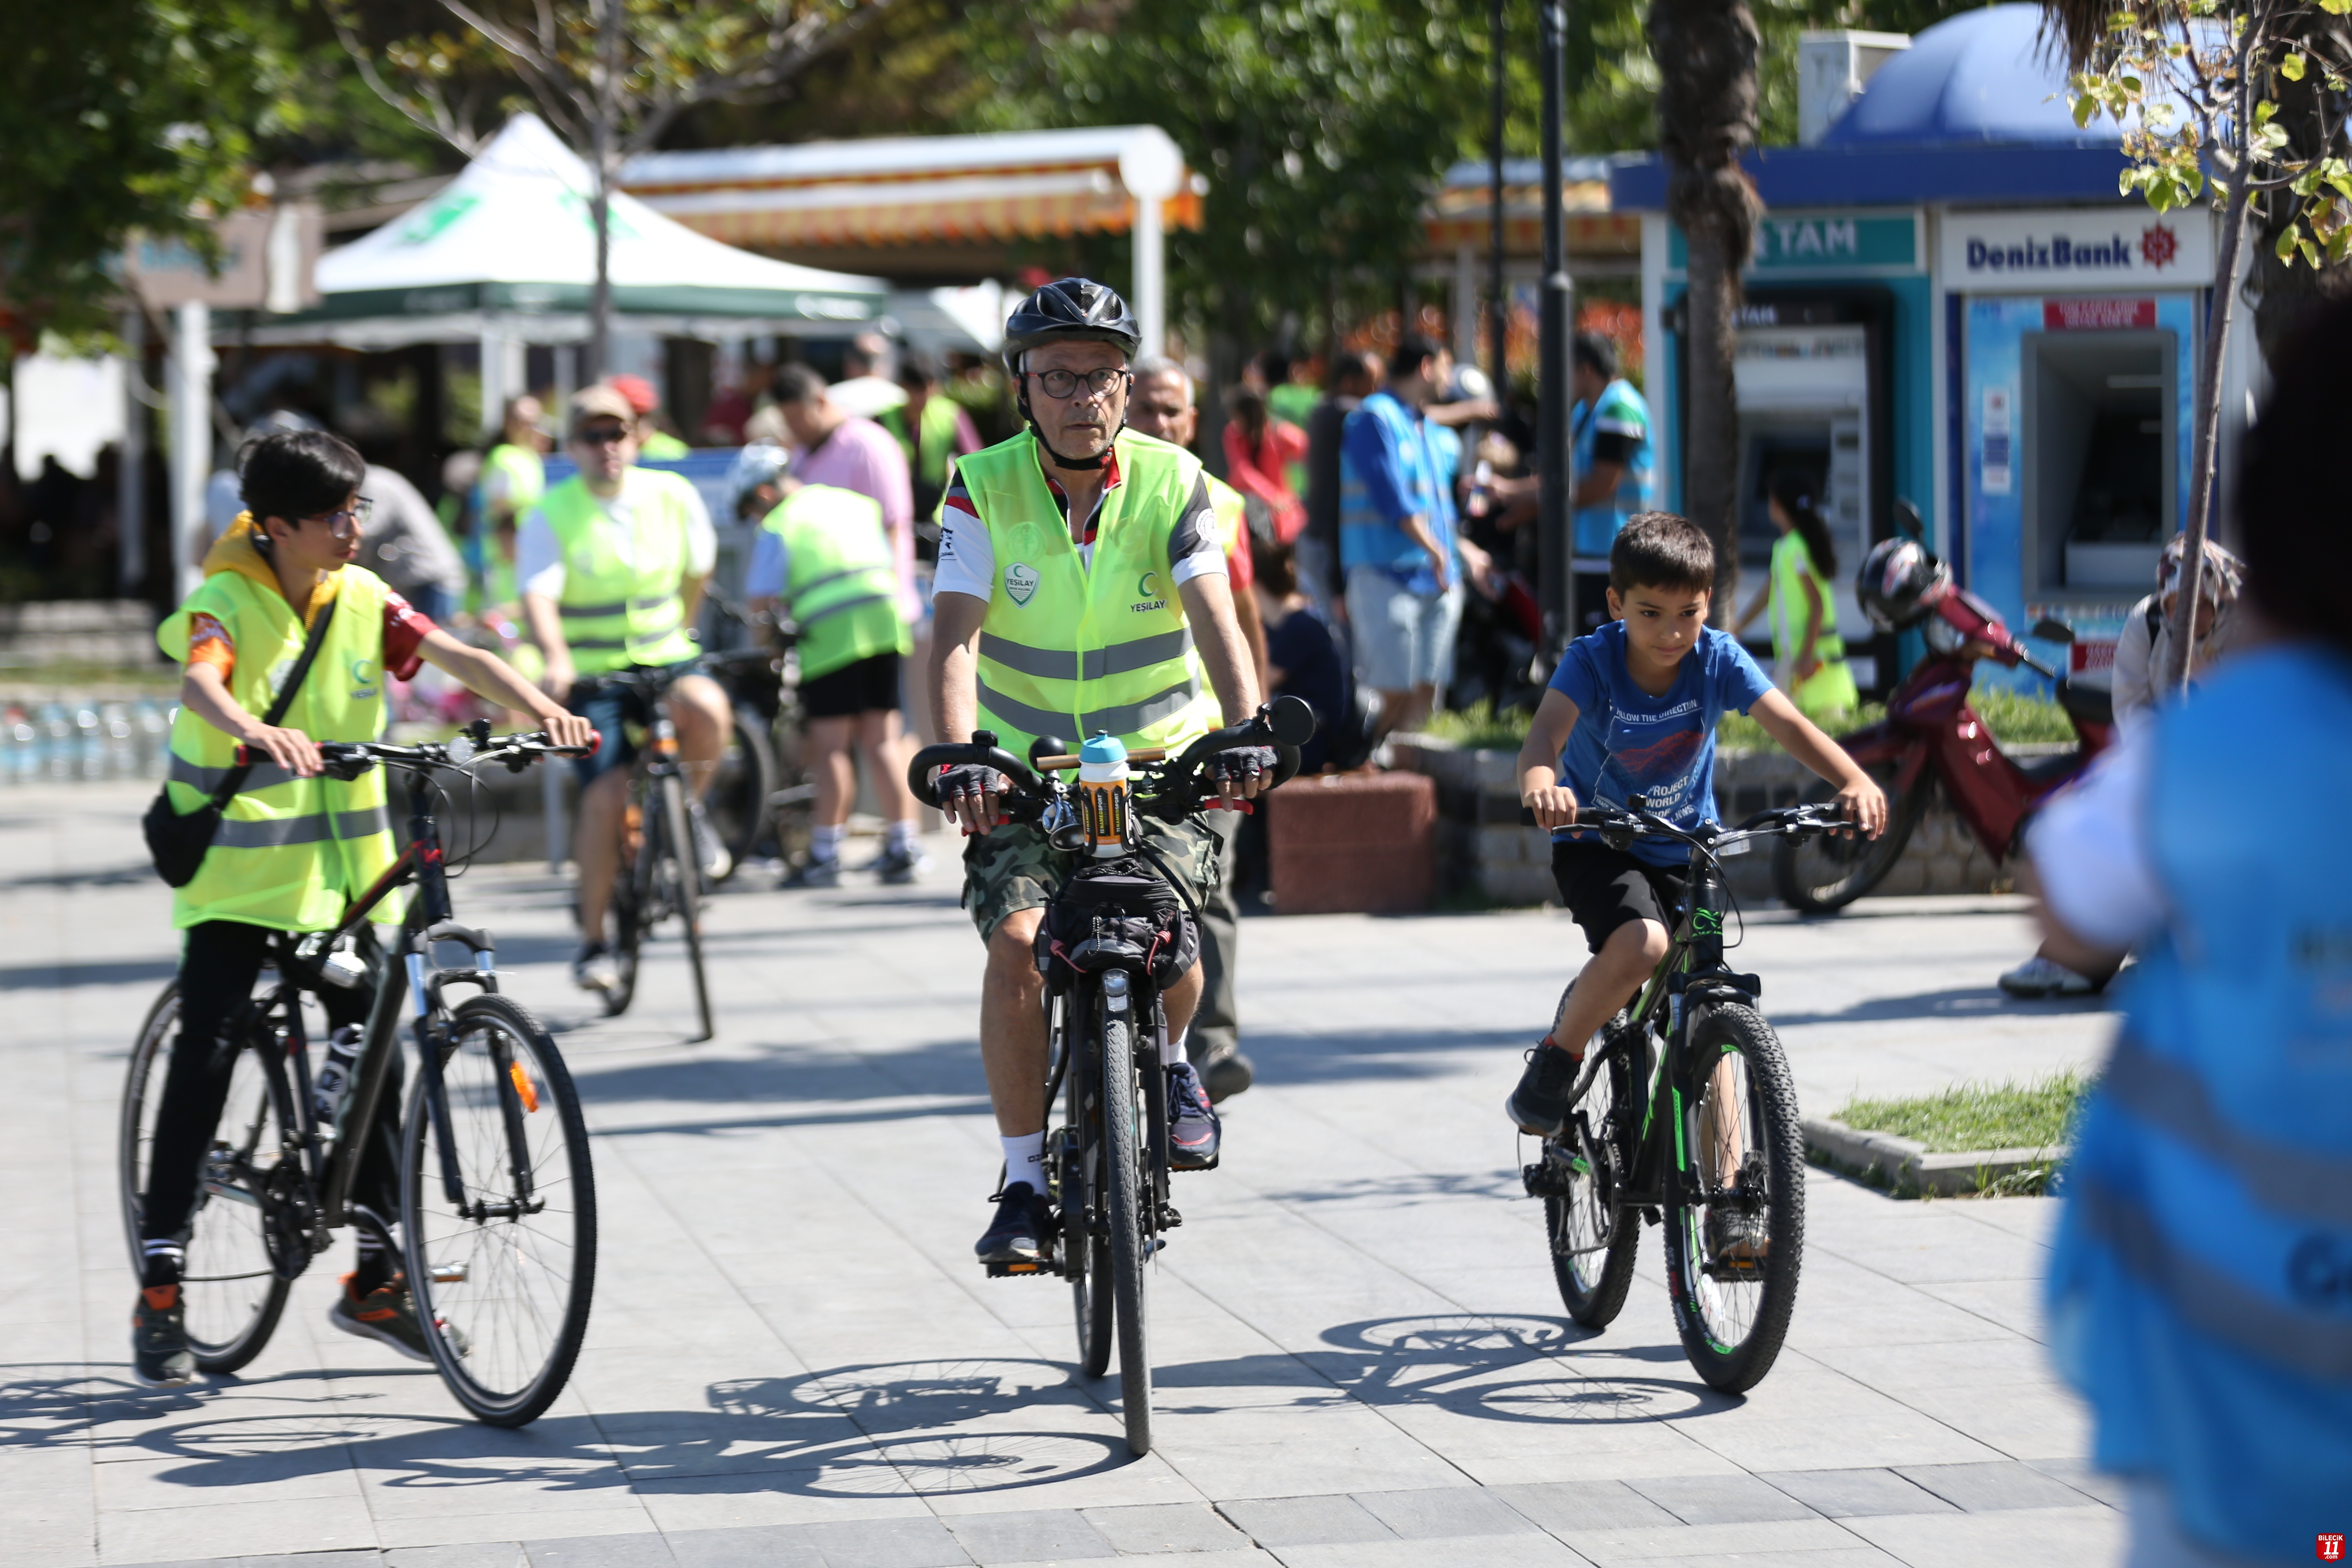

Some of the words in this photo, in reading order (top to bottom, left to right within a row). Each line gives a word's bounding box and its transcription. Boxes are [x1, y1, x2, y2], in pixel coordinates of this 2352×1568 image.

[1772, 218, 1857, 256] TAM
[1966, 234, 2132, 270] DenizBank
[1641, 714, 1657, 723] THE
[1647, 775, 1689, 795] PROJECT
[1646, 793, 1680, 808] WORLD
